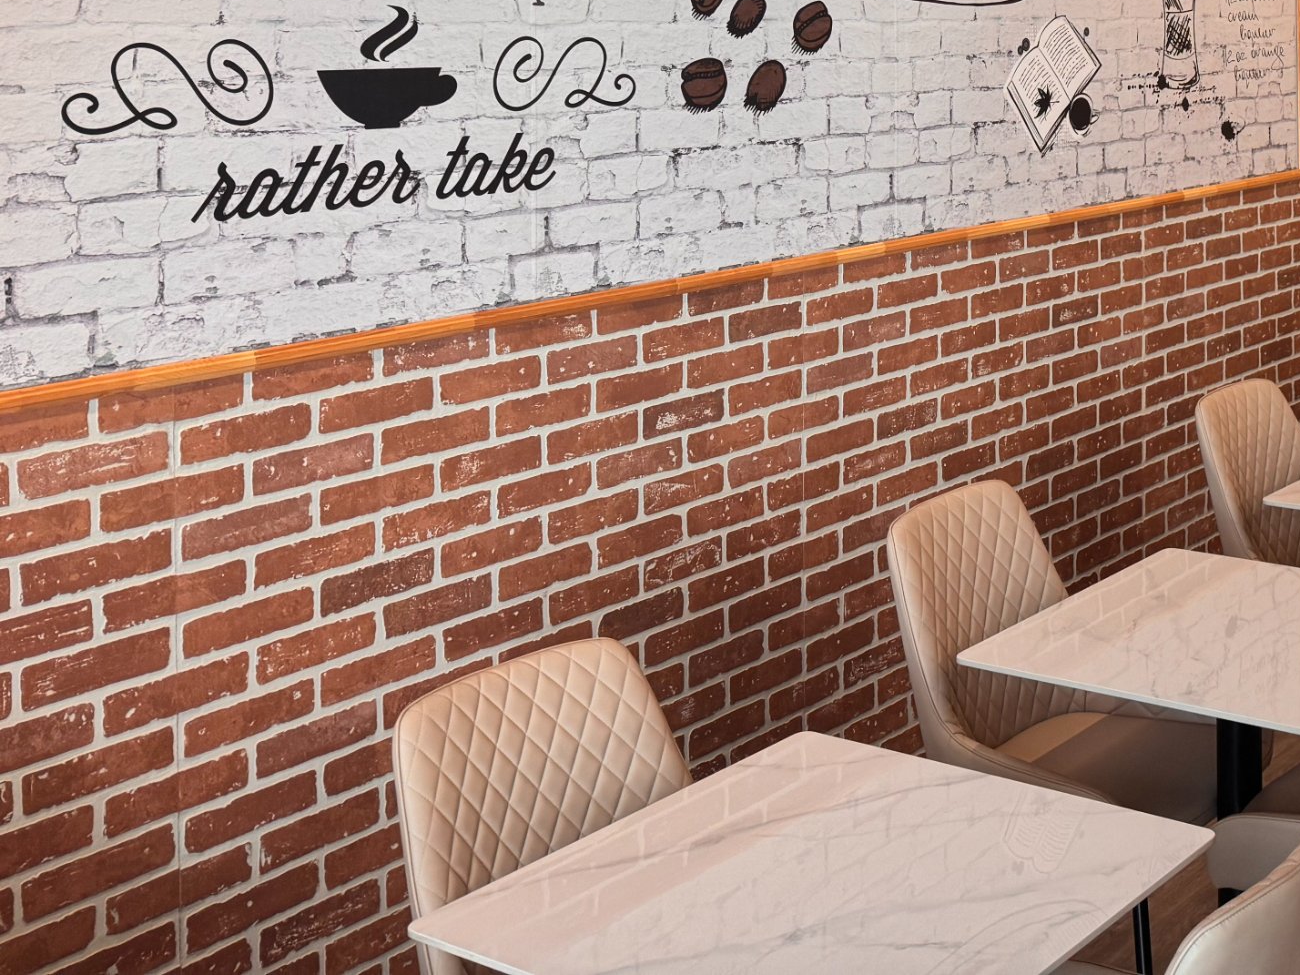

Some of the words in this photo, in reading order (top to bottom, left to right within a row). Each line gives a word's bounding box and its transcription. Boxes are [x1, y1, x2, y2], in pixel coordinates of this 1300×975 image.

[1227, 10, 1259, 23] cream
[1251, 45, 1285, 70] orange
[191, 144, 420, 223] rather
[435, 132, 557, 200] take
